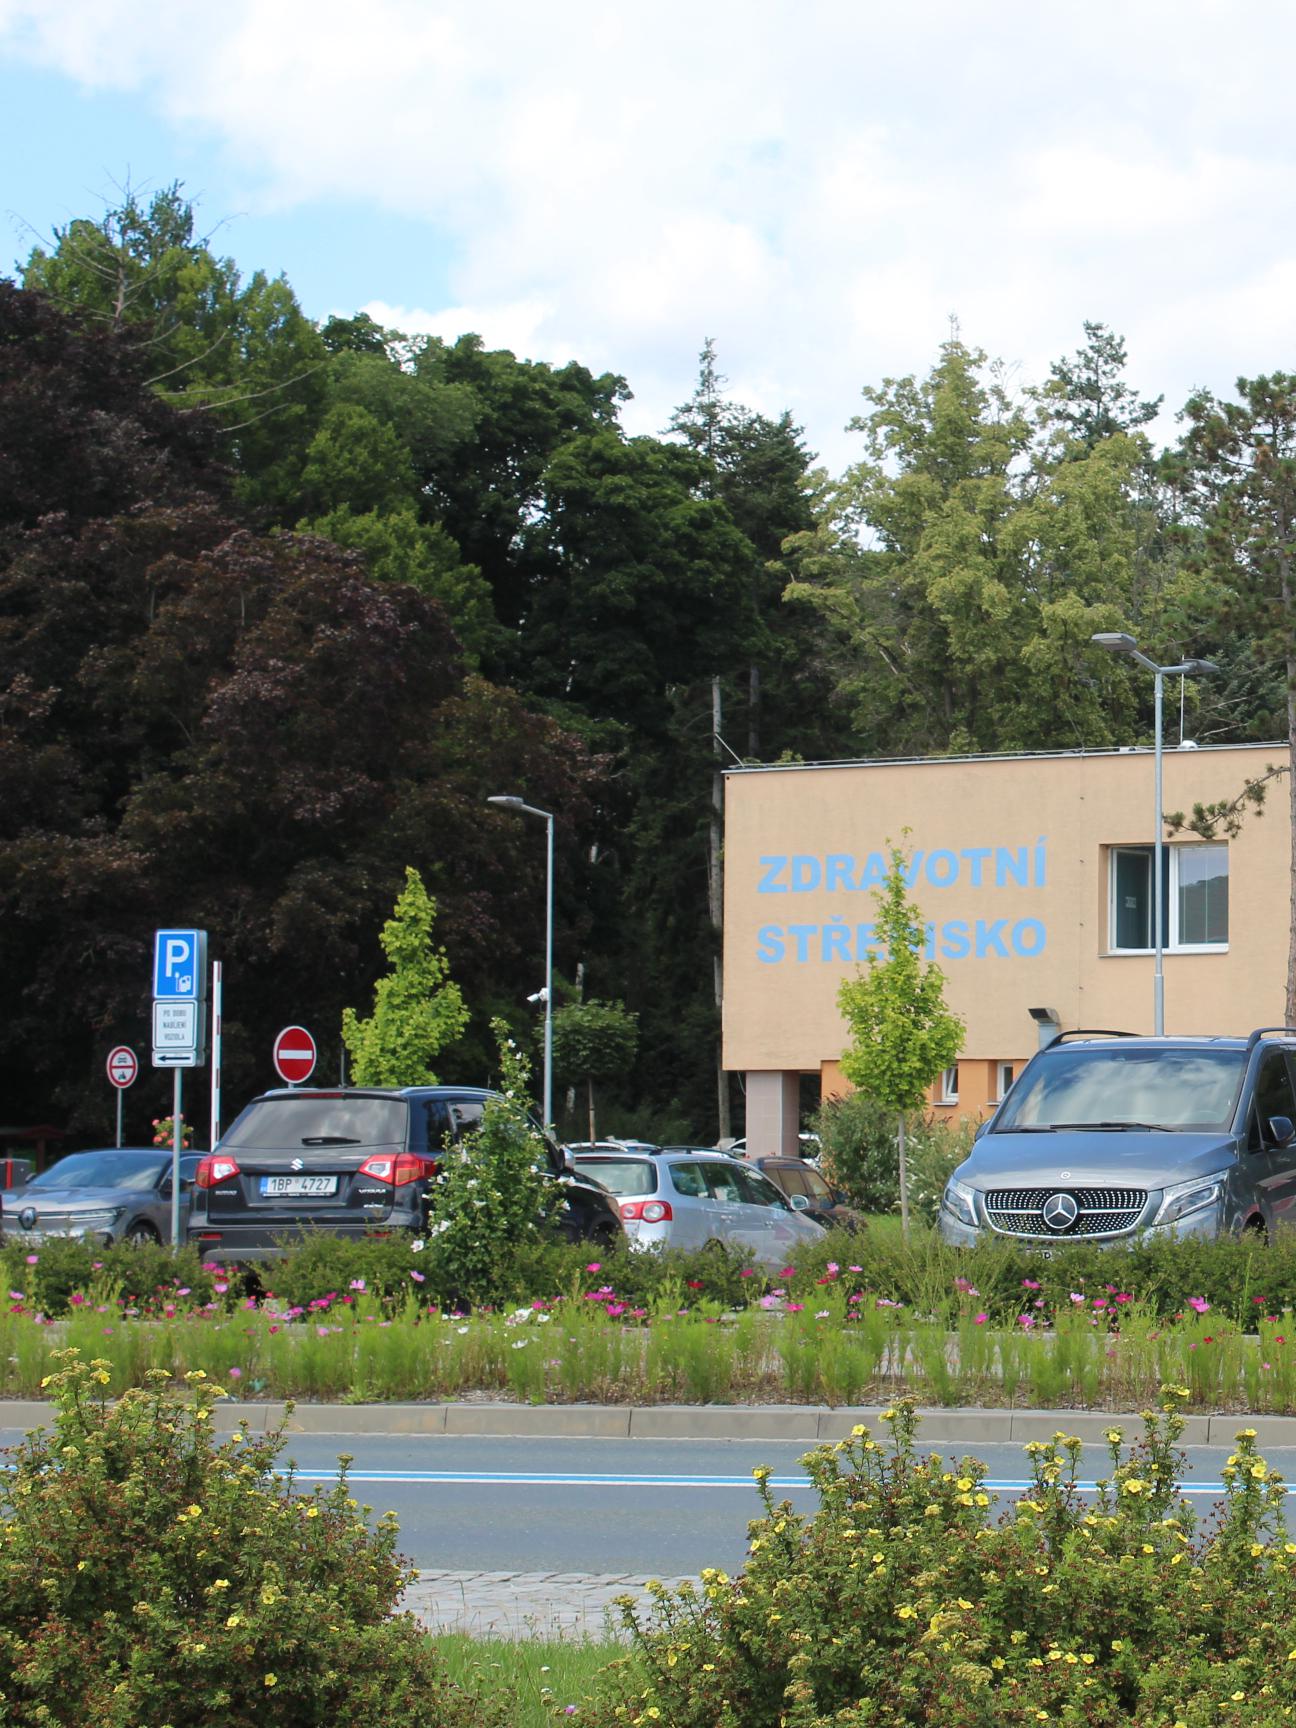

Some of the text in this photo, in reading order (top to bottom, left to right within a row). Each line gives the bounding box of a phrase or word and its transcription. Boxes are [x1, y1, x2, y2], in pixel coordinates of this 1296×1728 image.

[757, 835, 1048, 894] ZDRAVOTNÍ
[166, 939, 190, 977] P
[757, 914, 1048, 964] STŘEISKO
[271, 1177, 331, 1191] 1BP 4727
